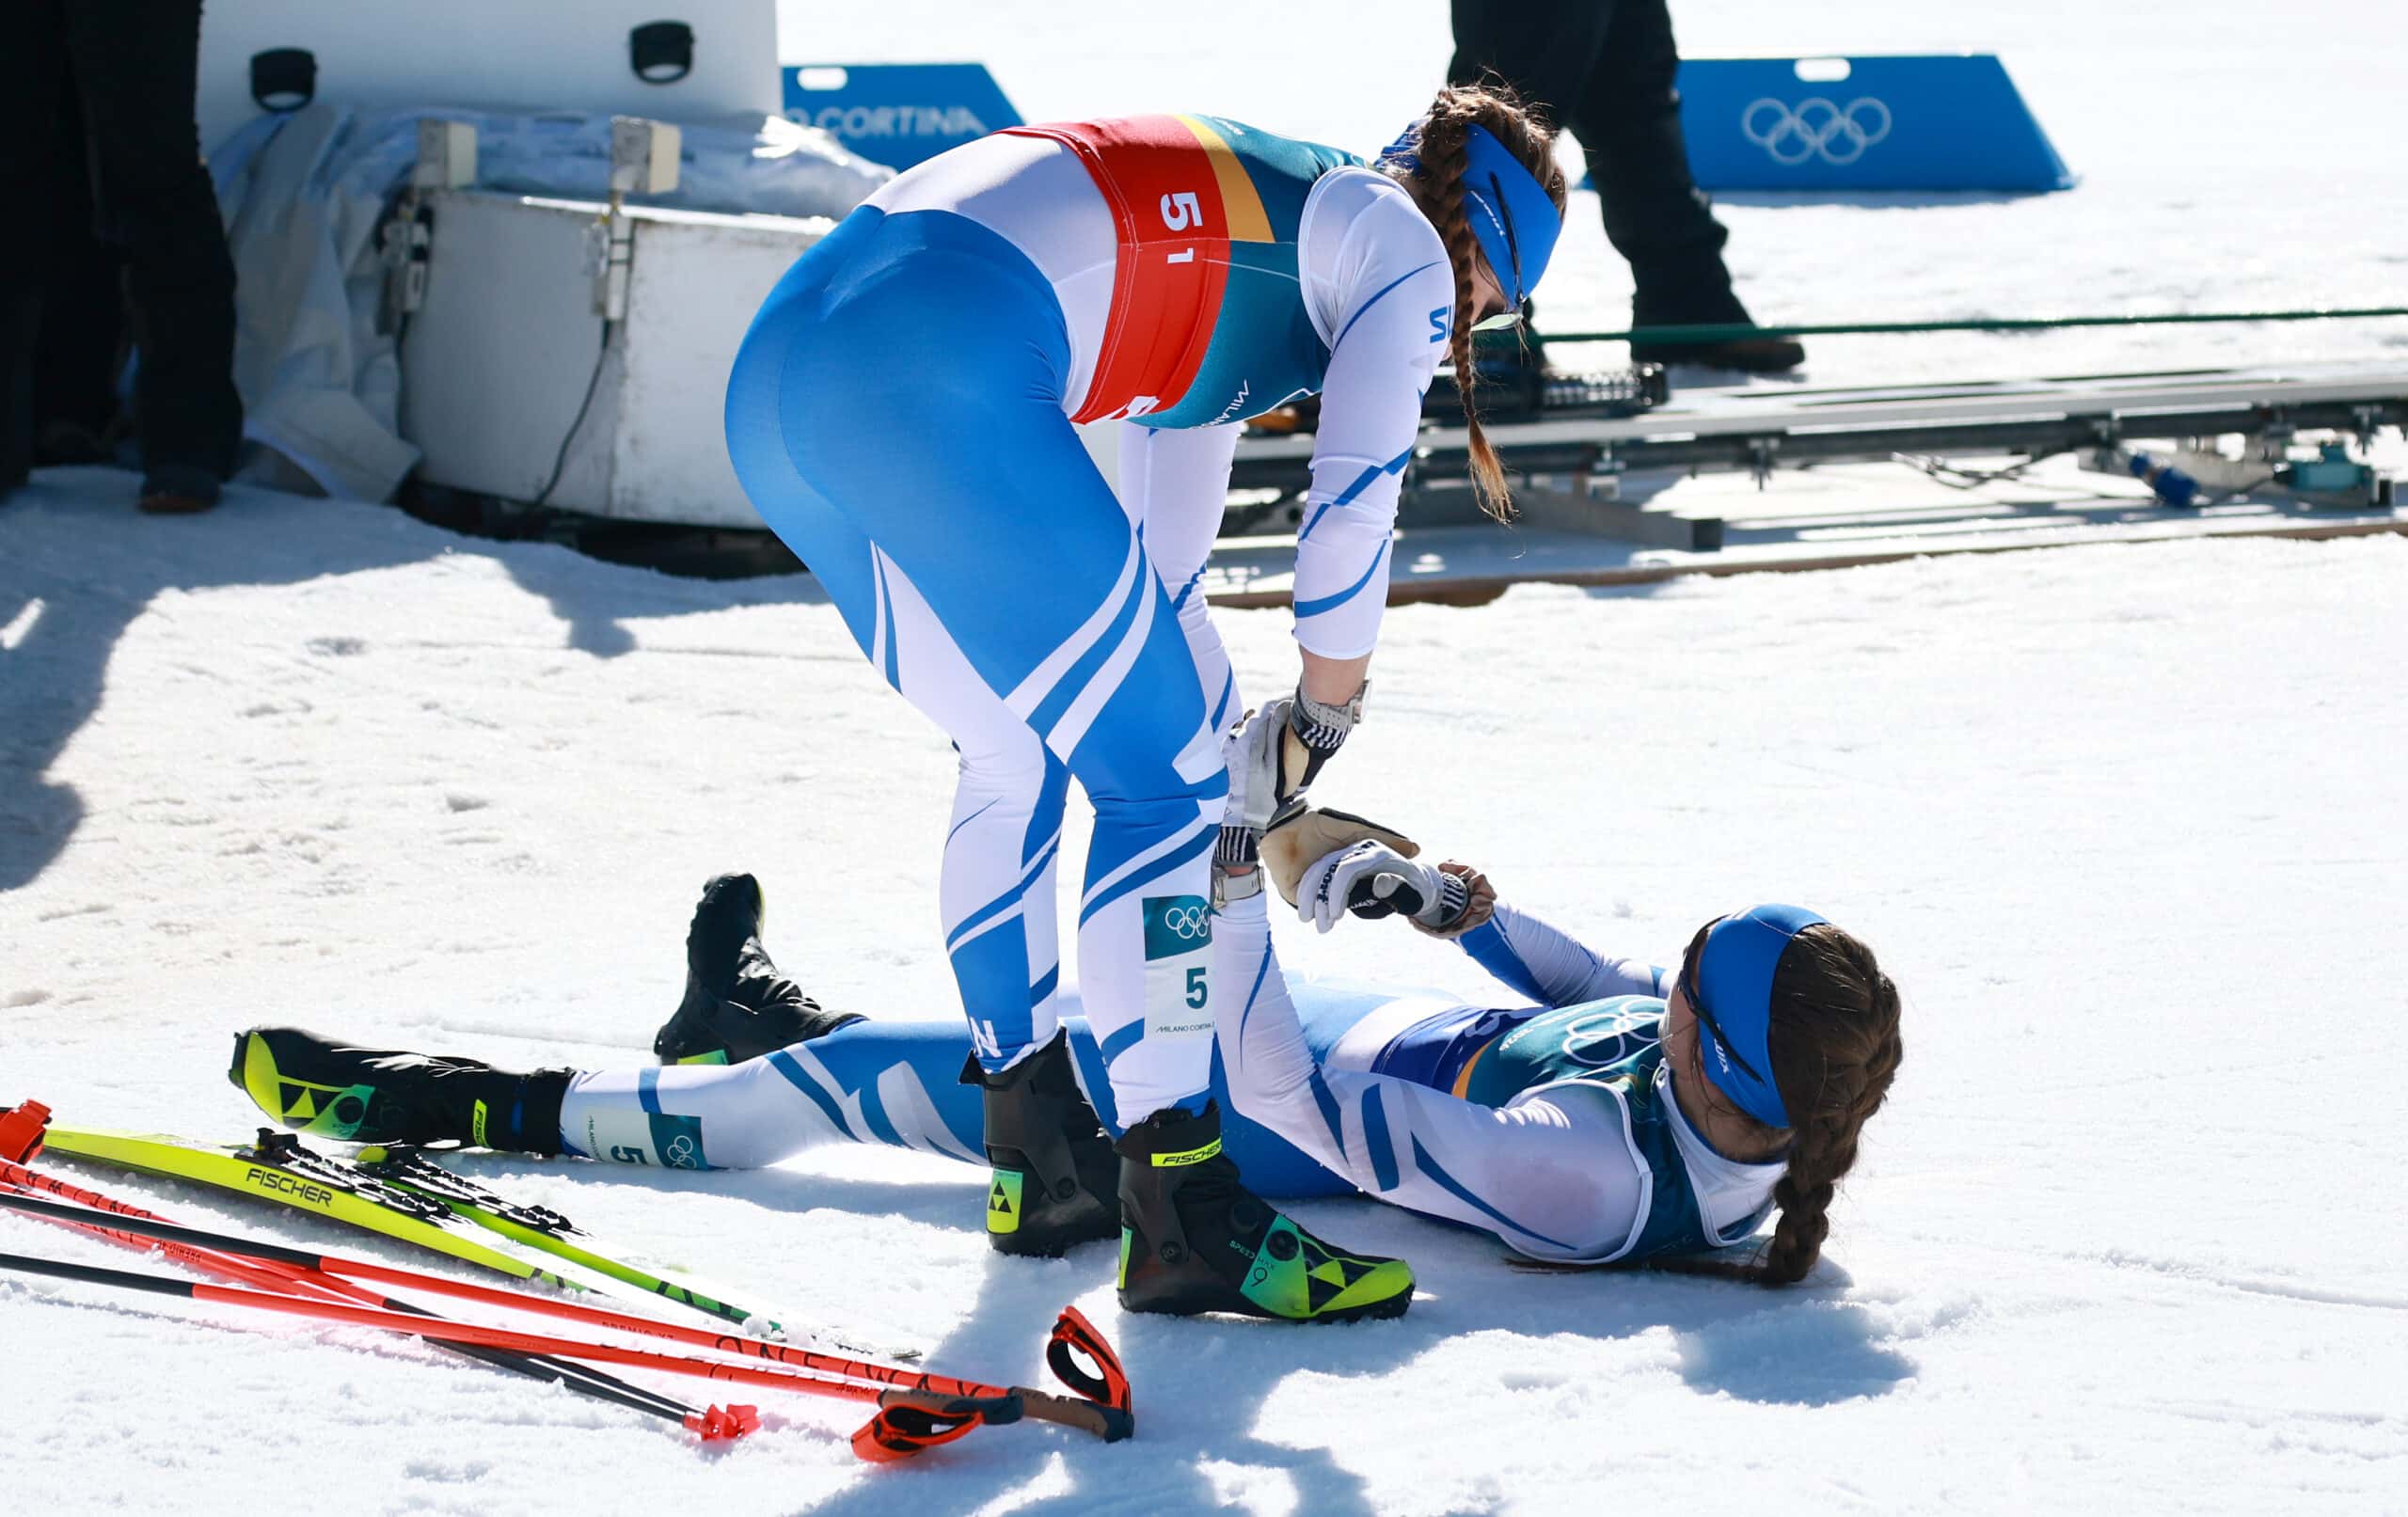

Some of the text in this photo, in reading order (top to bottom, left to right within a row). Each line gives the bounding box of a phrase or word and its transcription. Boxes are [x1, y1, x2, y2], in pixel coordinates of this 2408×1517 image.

[816, 106, 989, 139] CORTINA
[1161, 192, 1203, 232] 5
[1186, 966, 1208, 1010] 5
[246, 1167, 333, 1208] FISCHER
[1250, 1266, 1269, 1288] 9
